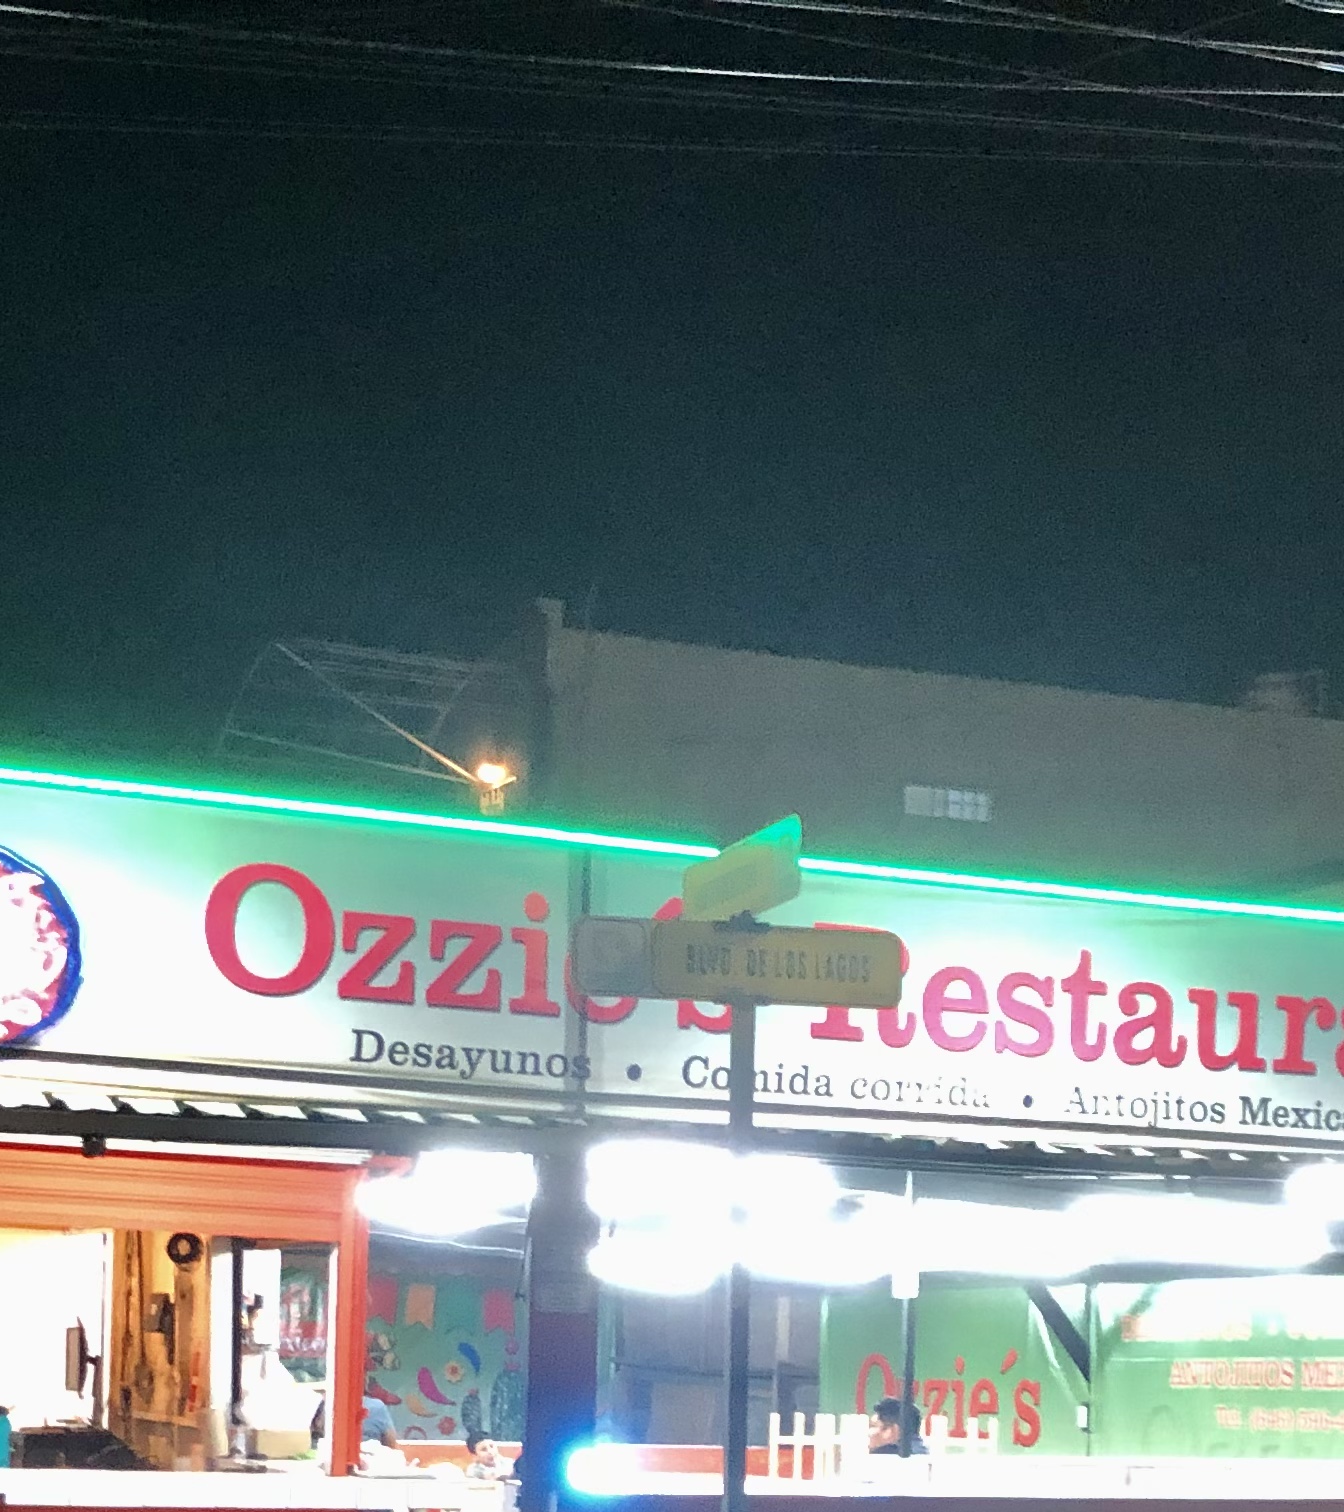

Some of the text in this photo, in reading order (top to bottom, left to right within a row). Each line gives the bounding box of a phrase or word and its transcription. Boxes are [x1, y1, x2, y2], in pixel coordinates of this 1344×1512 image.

[746, 949, 767, 979] DE
[774, 950, 808, 980] LOS
[814, 952, 871, 984] LAGOS
[349, 1028, 592, 1080] Desayunos
[1064, 1086, 1227, 1128] Antojitos
